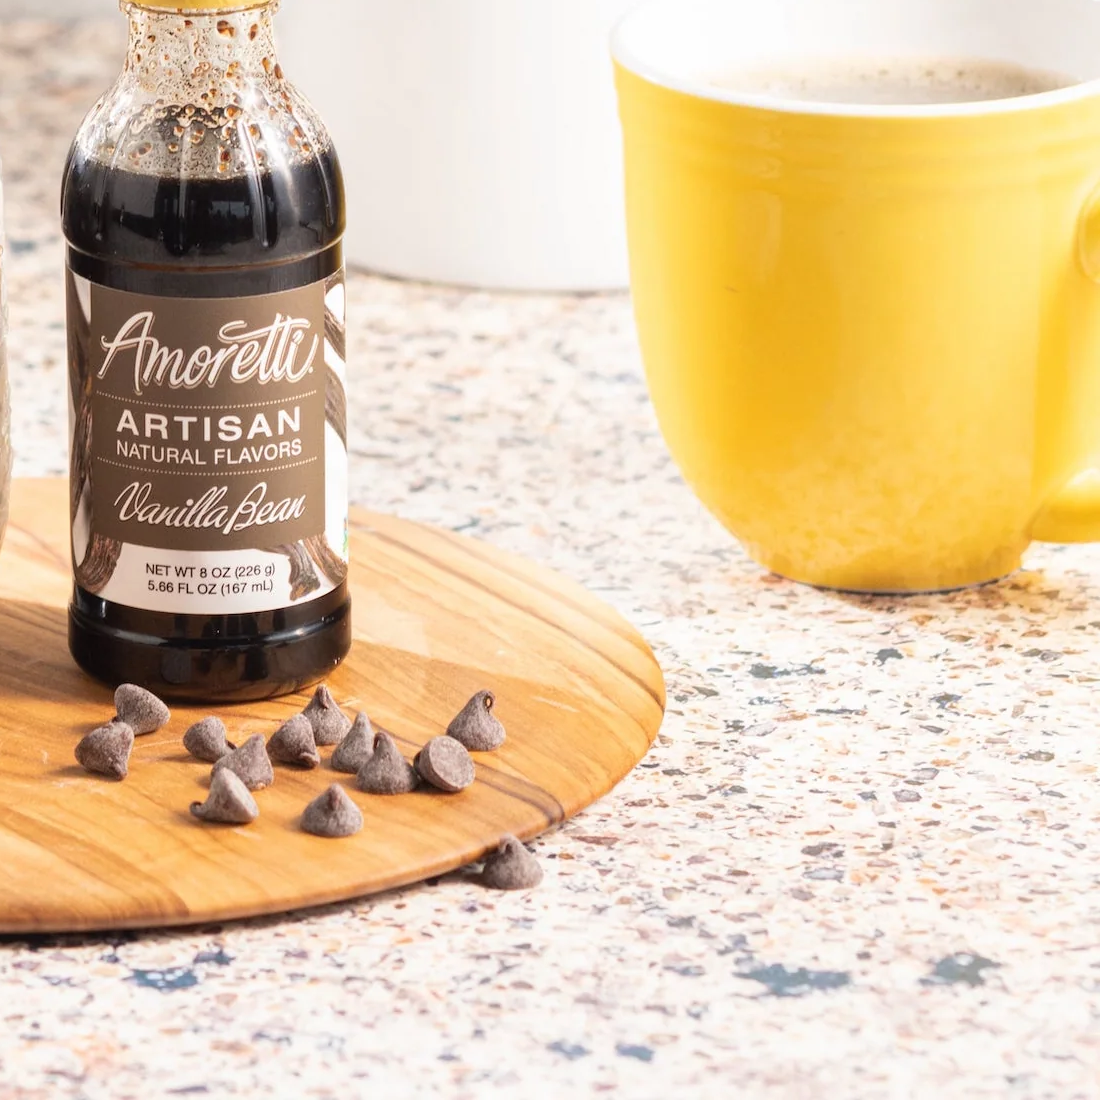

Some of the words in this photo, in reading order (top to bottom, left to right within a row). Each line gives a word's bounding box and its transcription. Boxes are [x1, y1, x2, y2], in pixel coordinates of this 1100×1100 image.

[116, 406, 300, 441] ARTISAN
[116, 439, 206, 465] NATURAL
[214, 440, 302, 465] FLAVORS
[114, 481, 228, 528] Vanilla
[223, 481, 306, 534] Bean
[145, 563, 171, 576] NET
[174, 566, 196, 578] WT
[199, 567, 207, 579] 8
[211, 567, 231, 578] OZ
[234, 565, 261, 579] (226
[264, 562, 276, 577] g)
[147, 580, 174, 593] 5.66
[178, 583, 194, 594] FL
[197, 583, 217, 595] OZ
[220, 582, 247, 597] (167
[251, 579, 274, 592] mL)
